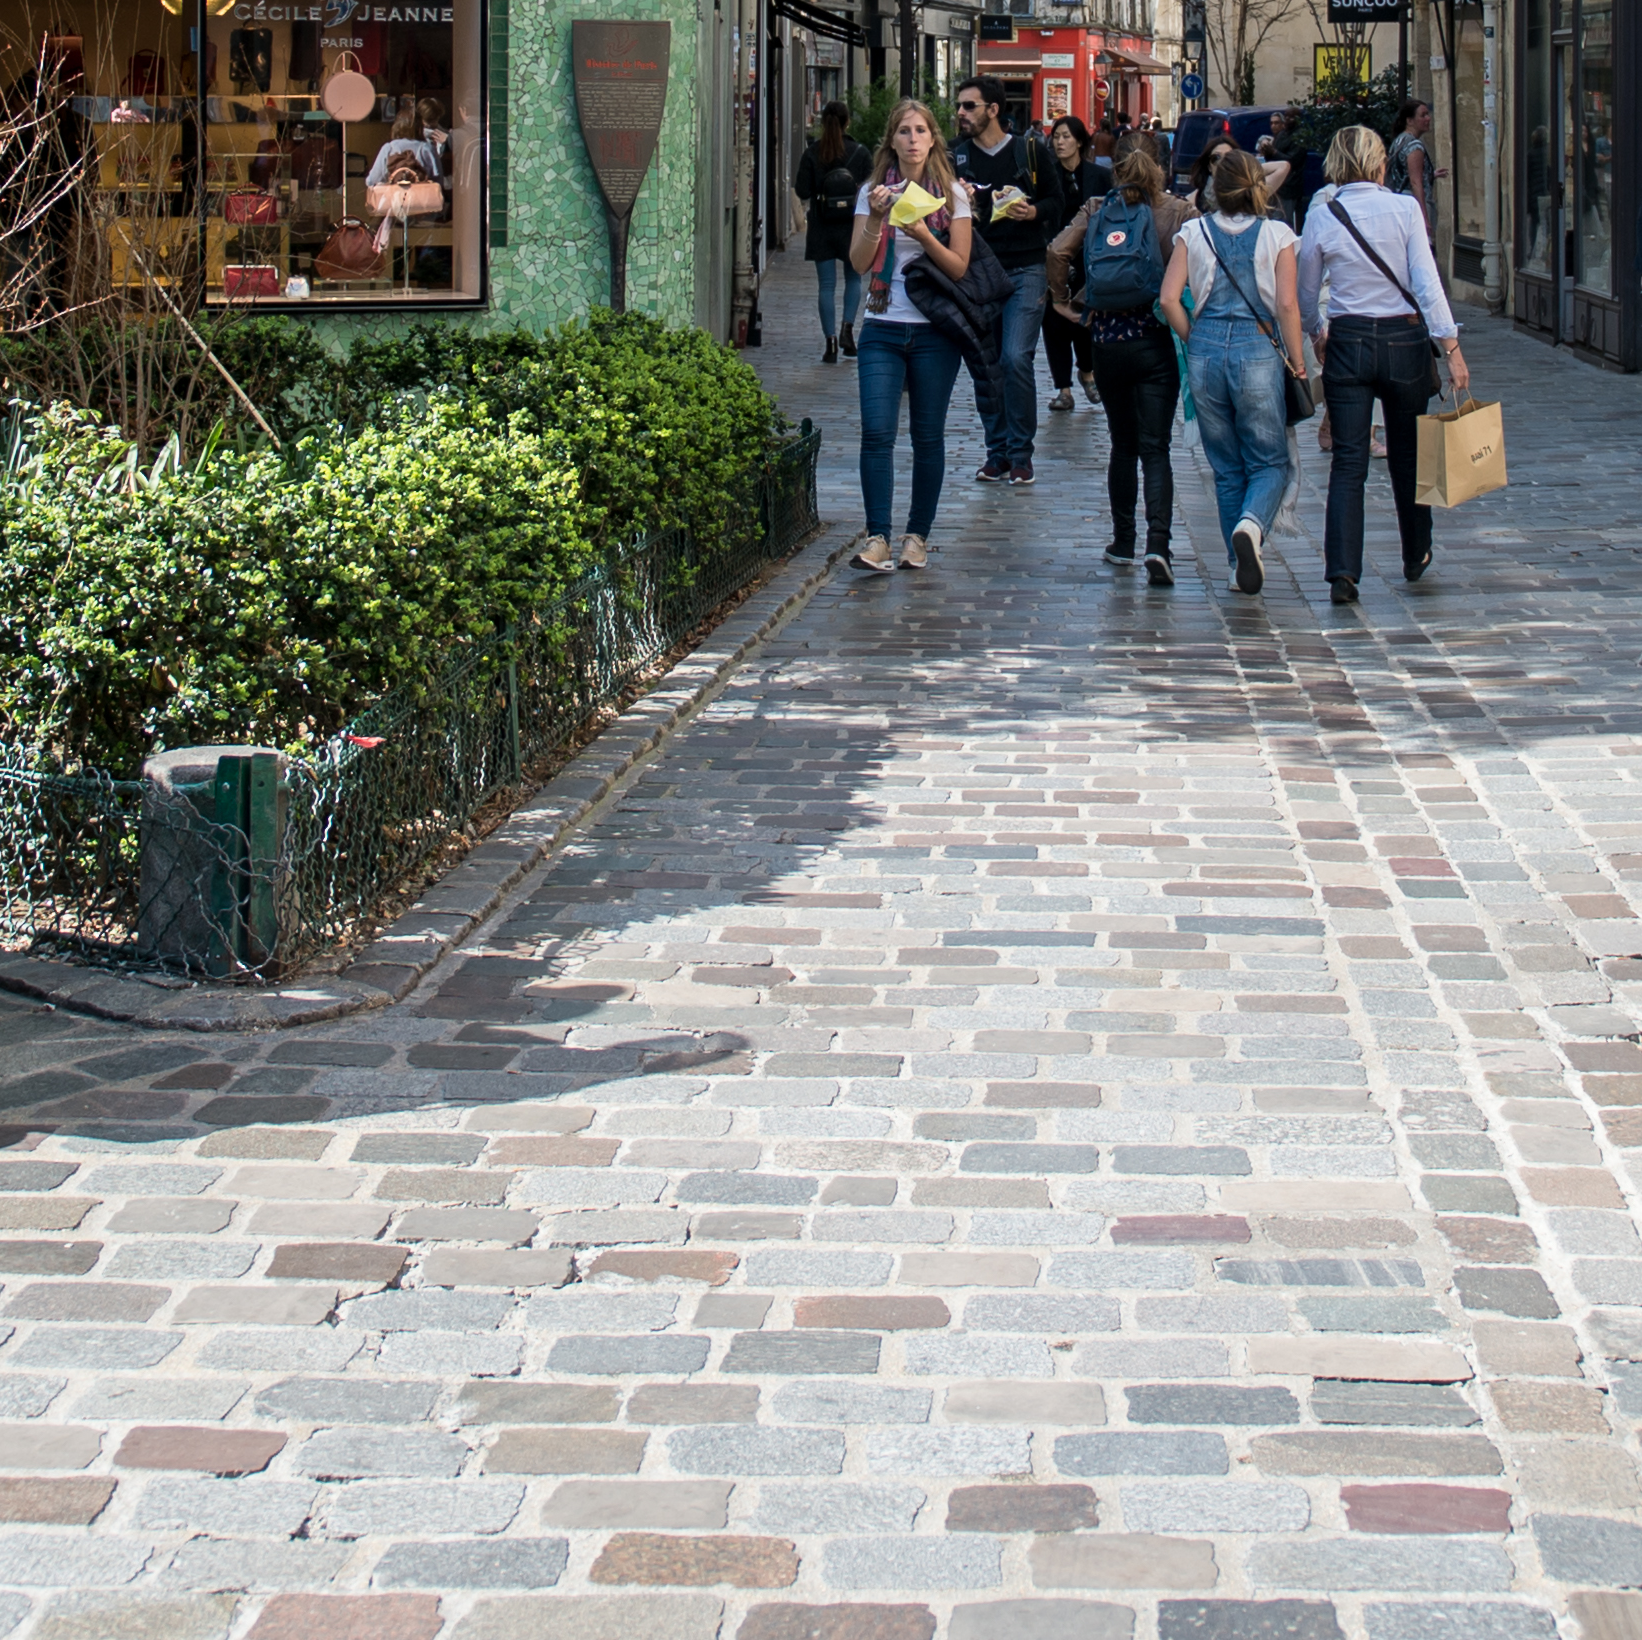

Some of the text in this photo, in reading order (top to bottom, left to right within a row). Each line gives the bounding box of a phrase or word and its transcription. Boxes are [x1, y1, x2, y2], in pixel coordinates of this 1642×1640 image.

[234, 0, 454, 22] CÉCILE JEANNE
[320, 38, 364, 48] PARIS
